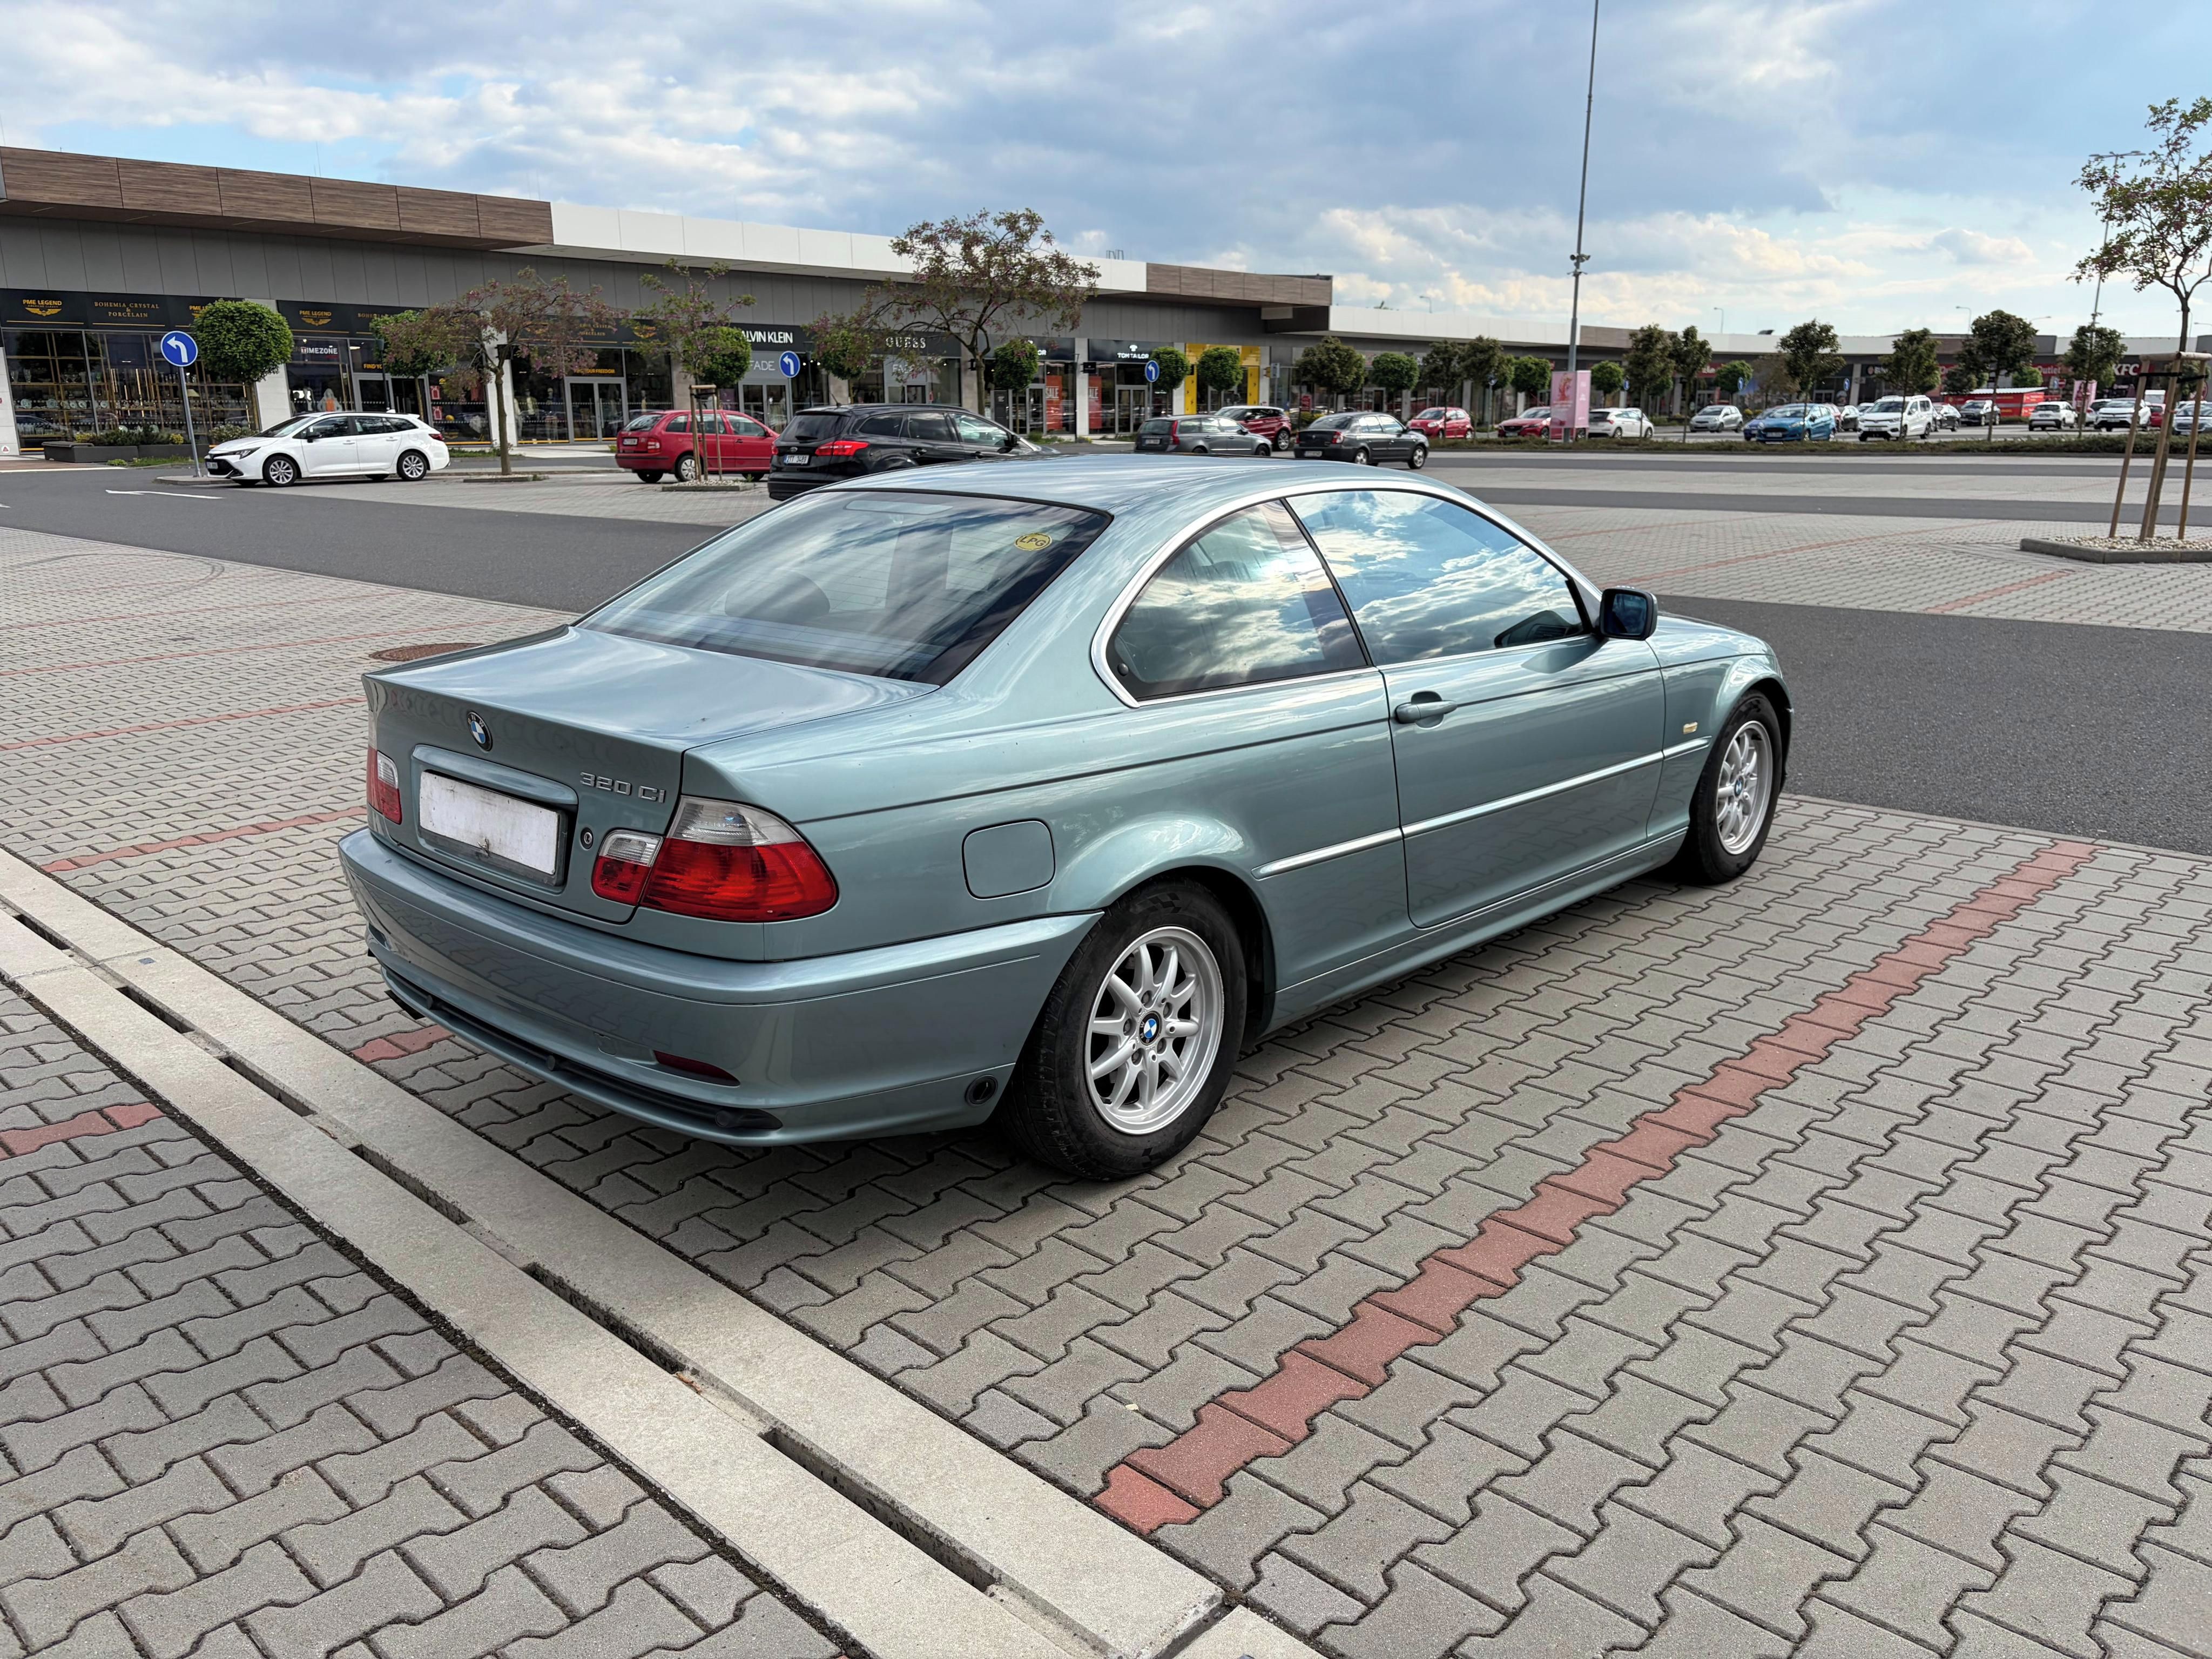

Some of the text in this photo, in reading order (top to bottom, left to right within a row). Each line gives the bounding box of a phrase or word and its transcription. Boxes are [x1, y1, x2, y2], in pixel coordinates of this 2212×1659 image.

[767, 331, 793, 343] KLEIN
[2038, 365, 2061, 374] Outlet
[2112, 363, 2139, 375] KFC
[1046, 388, 1059, 399] SALE
[1020, 536, 1047, 547] LPG
[579, 772, 632, 796] 320
